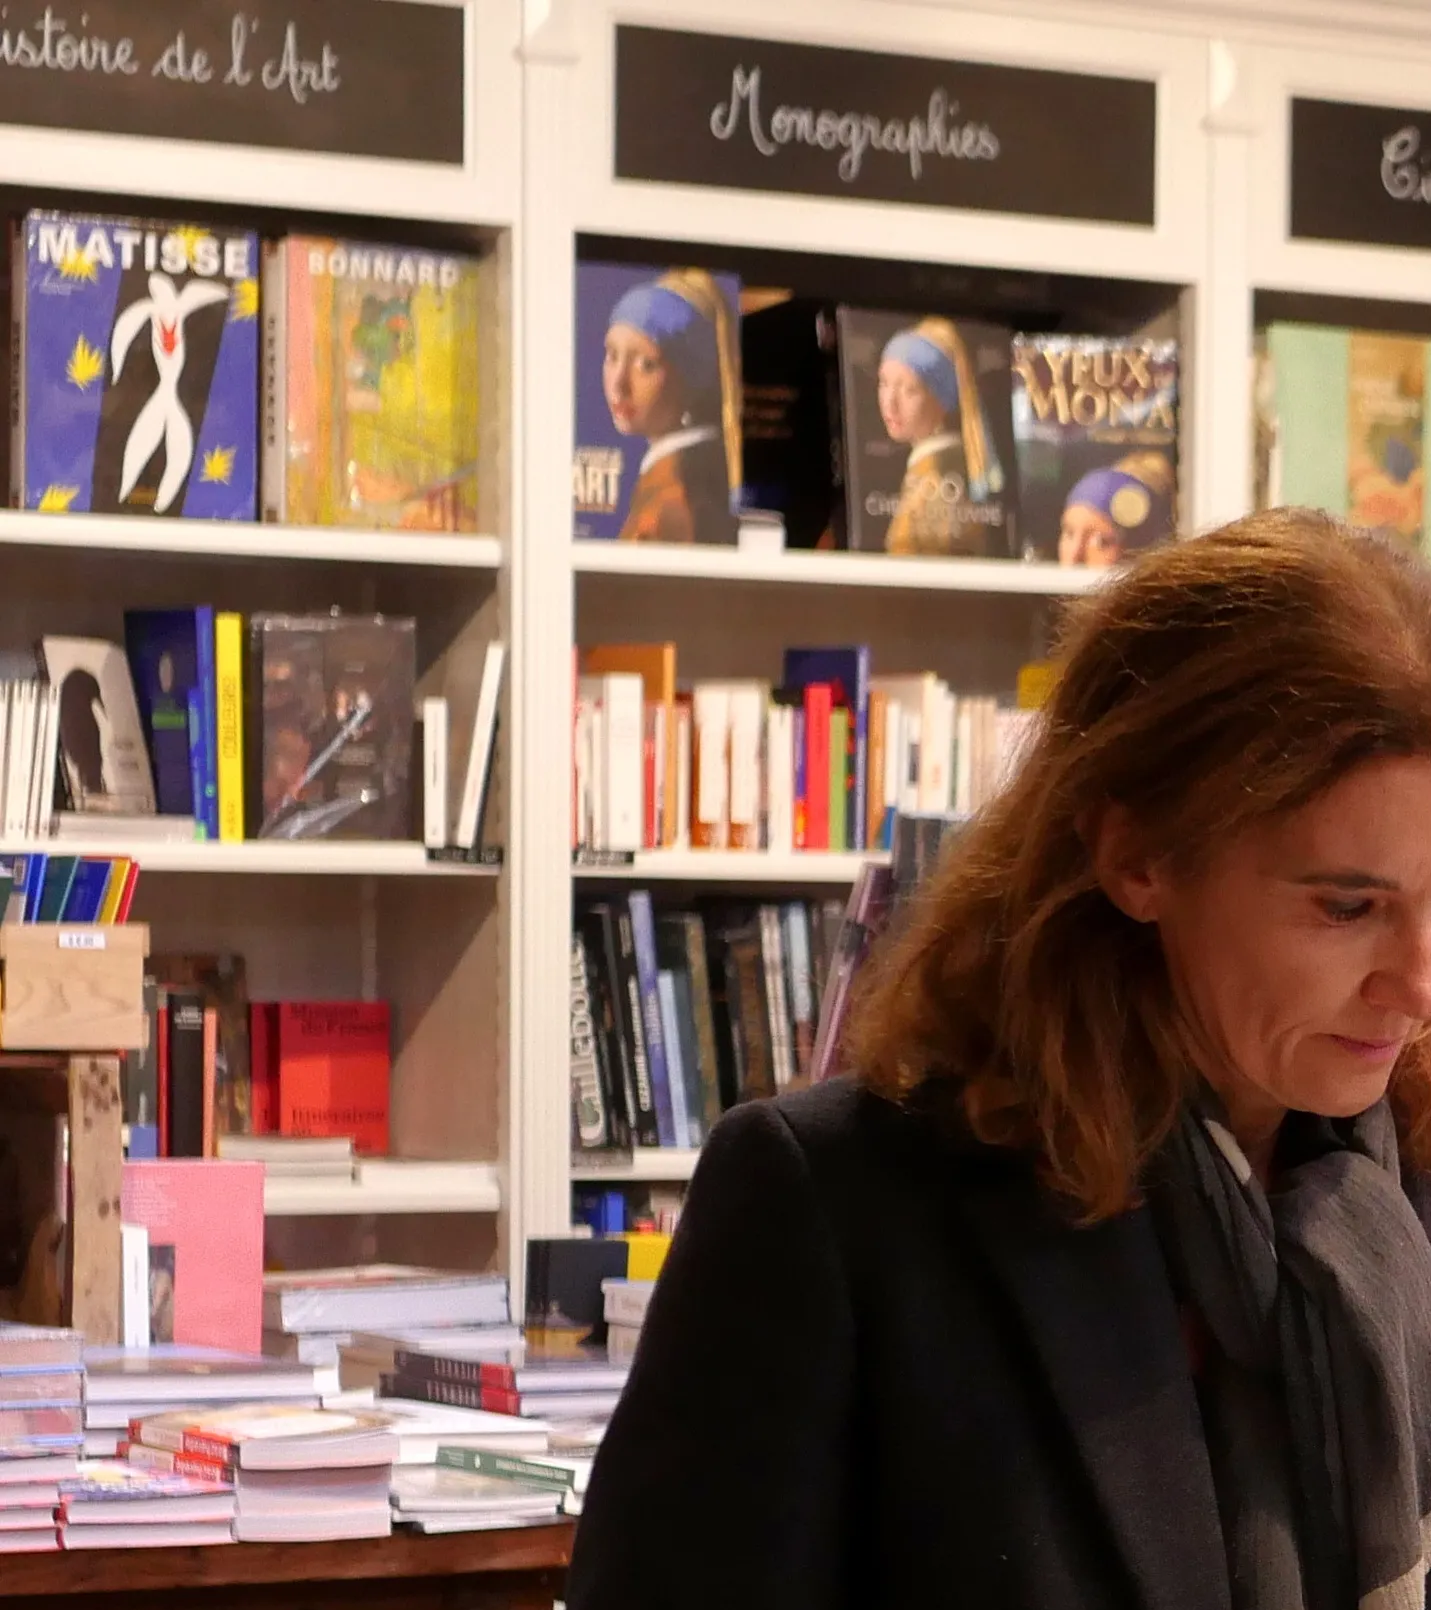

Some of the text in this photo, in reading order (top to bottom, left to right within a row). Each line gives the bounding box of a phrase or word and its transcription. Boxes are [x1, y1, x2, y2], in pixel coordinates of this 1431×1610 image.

[0, 5, 341, 103] istoire de l'Art
[711, 65, 1000, 181] Monographies
[39, 222, 250, 279] MATISSE
[307, 249, 462, 289] BONNARD
